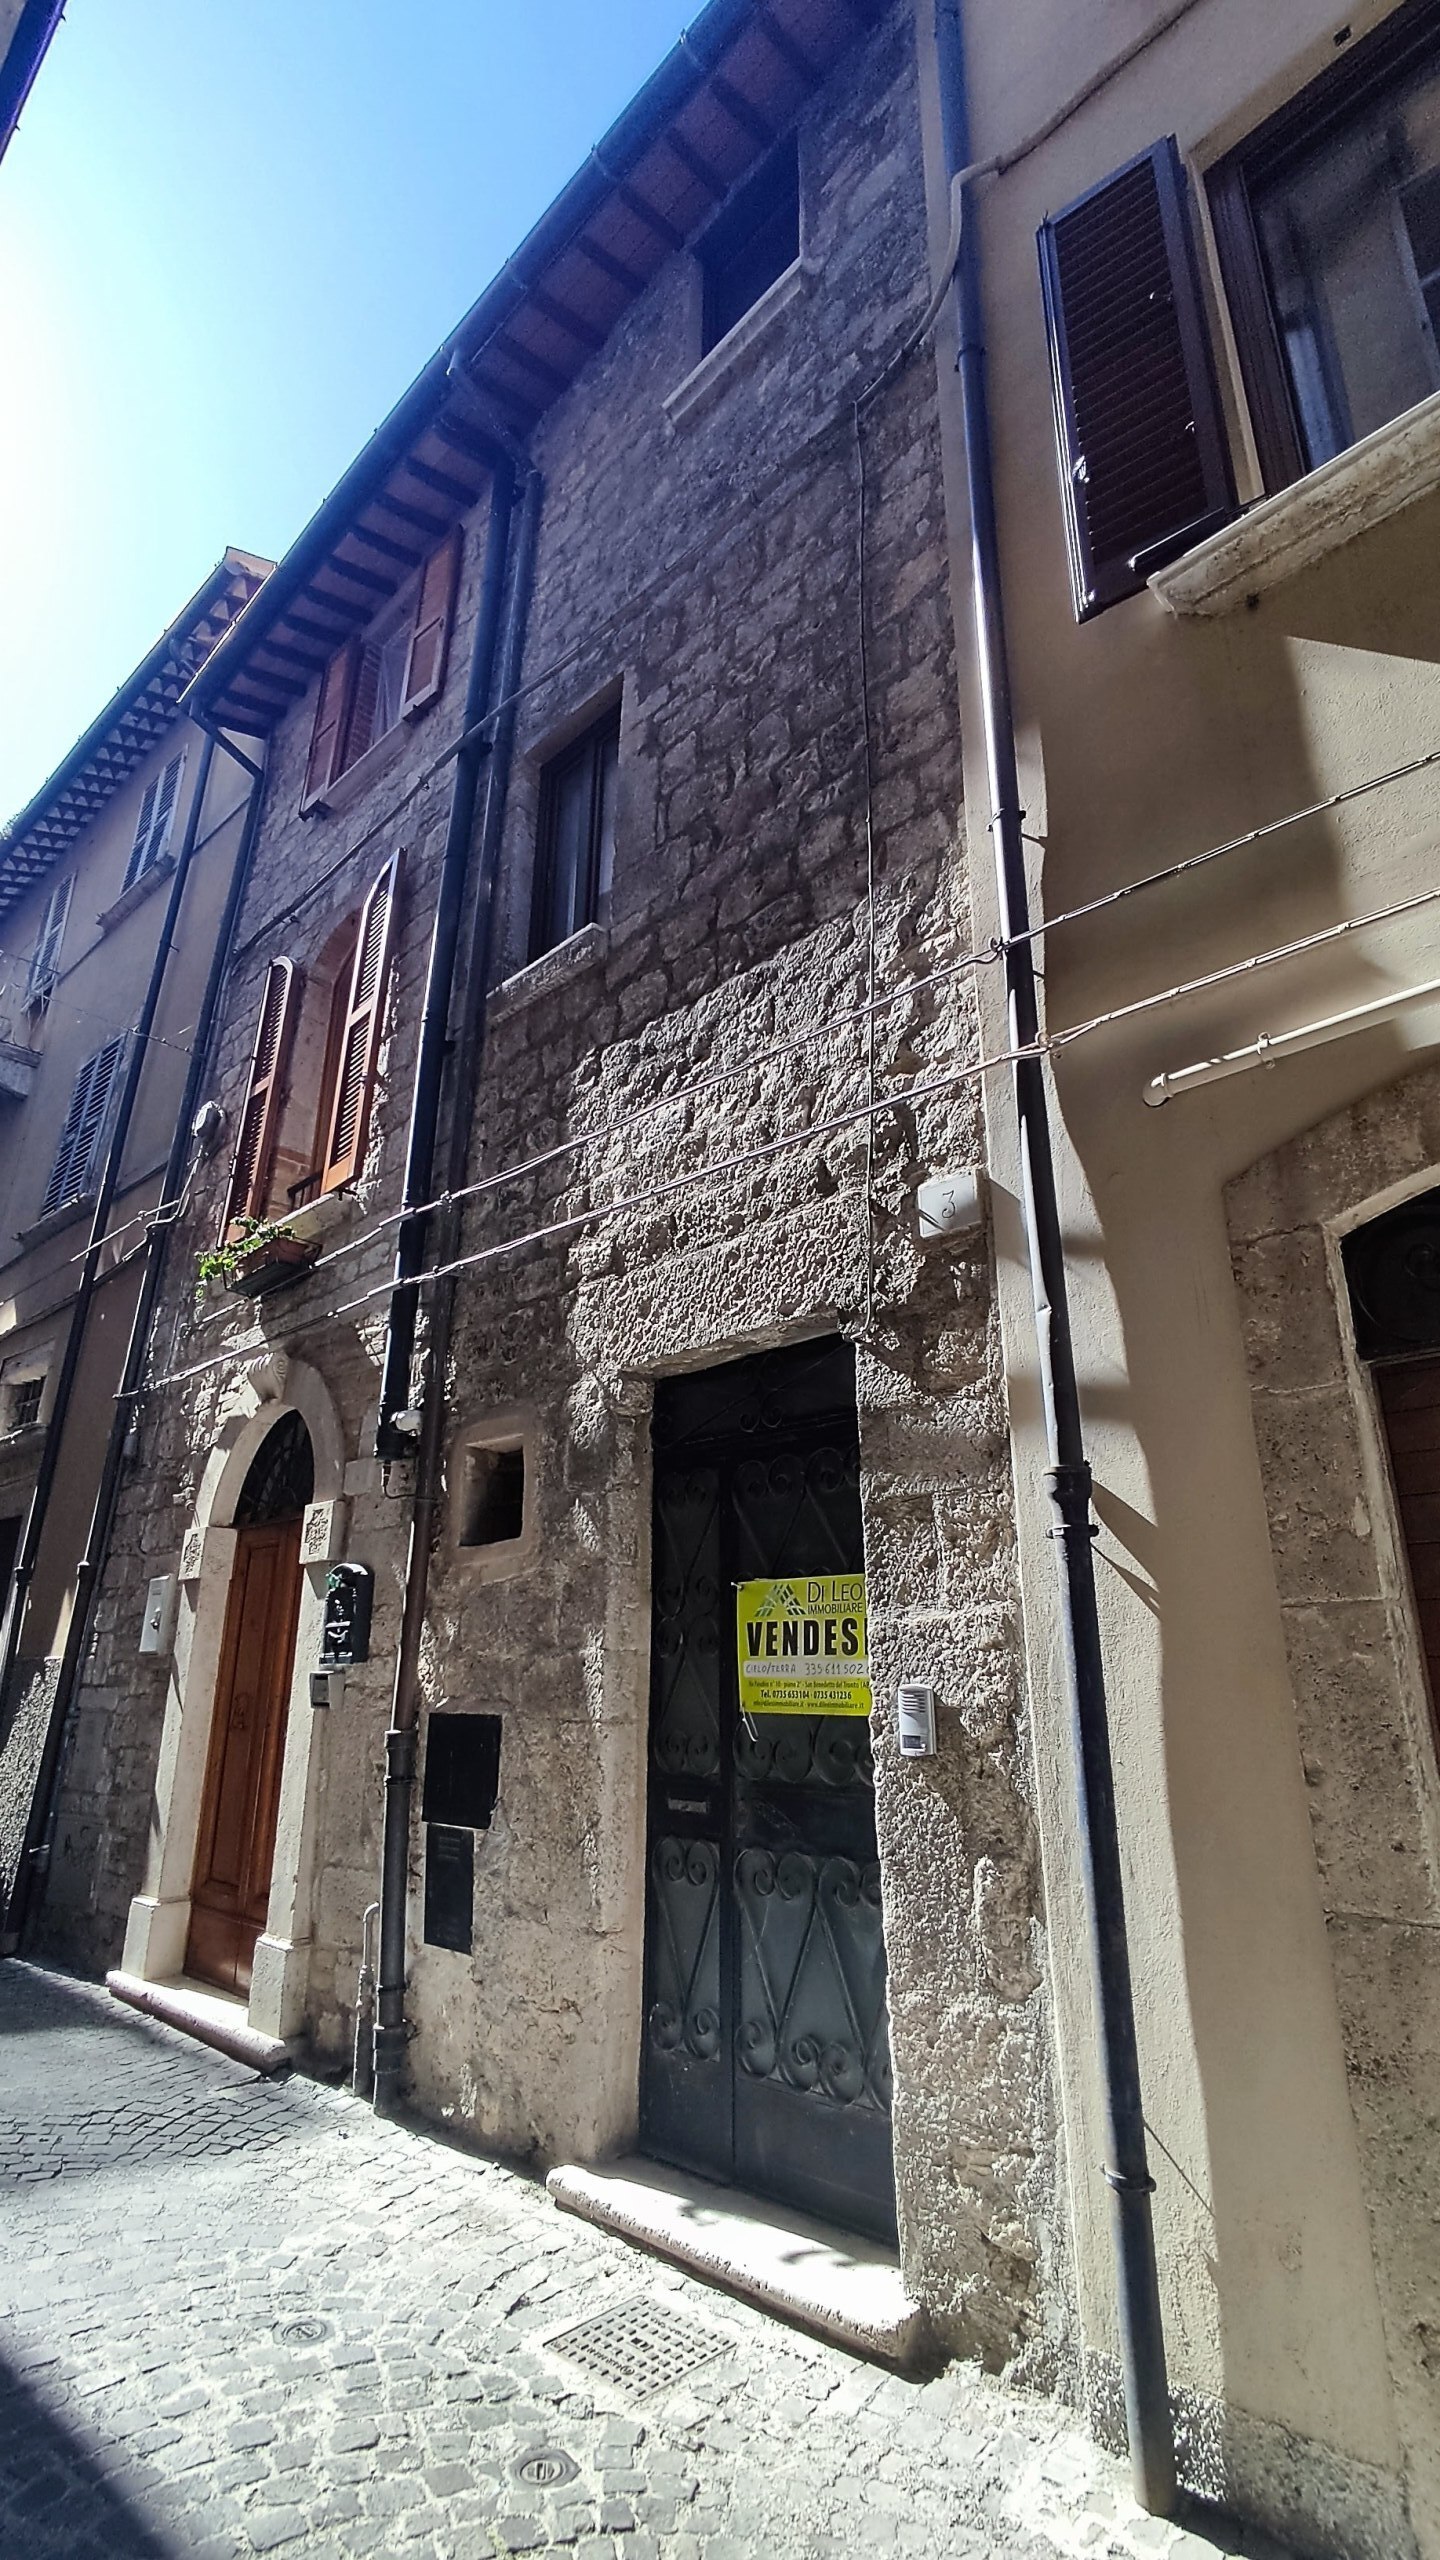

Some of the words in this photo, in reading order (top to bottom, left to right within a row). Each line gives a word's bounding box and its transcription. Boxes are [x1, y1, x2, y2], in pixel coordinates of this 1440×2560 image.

[941, 1189, 956, 1219] 3
[832, 1580, 863, 1602] LEO
[807, 1603, 863, 1615] IMMOBILIARE
[760, 1689, 772, 1699] Tel.
